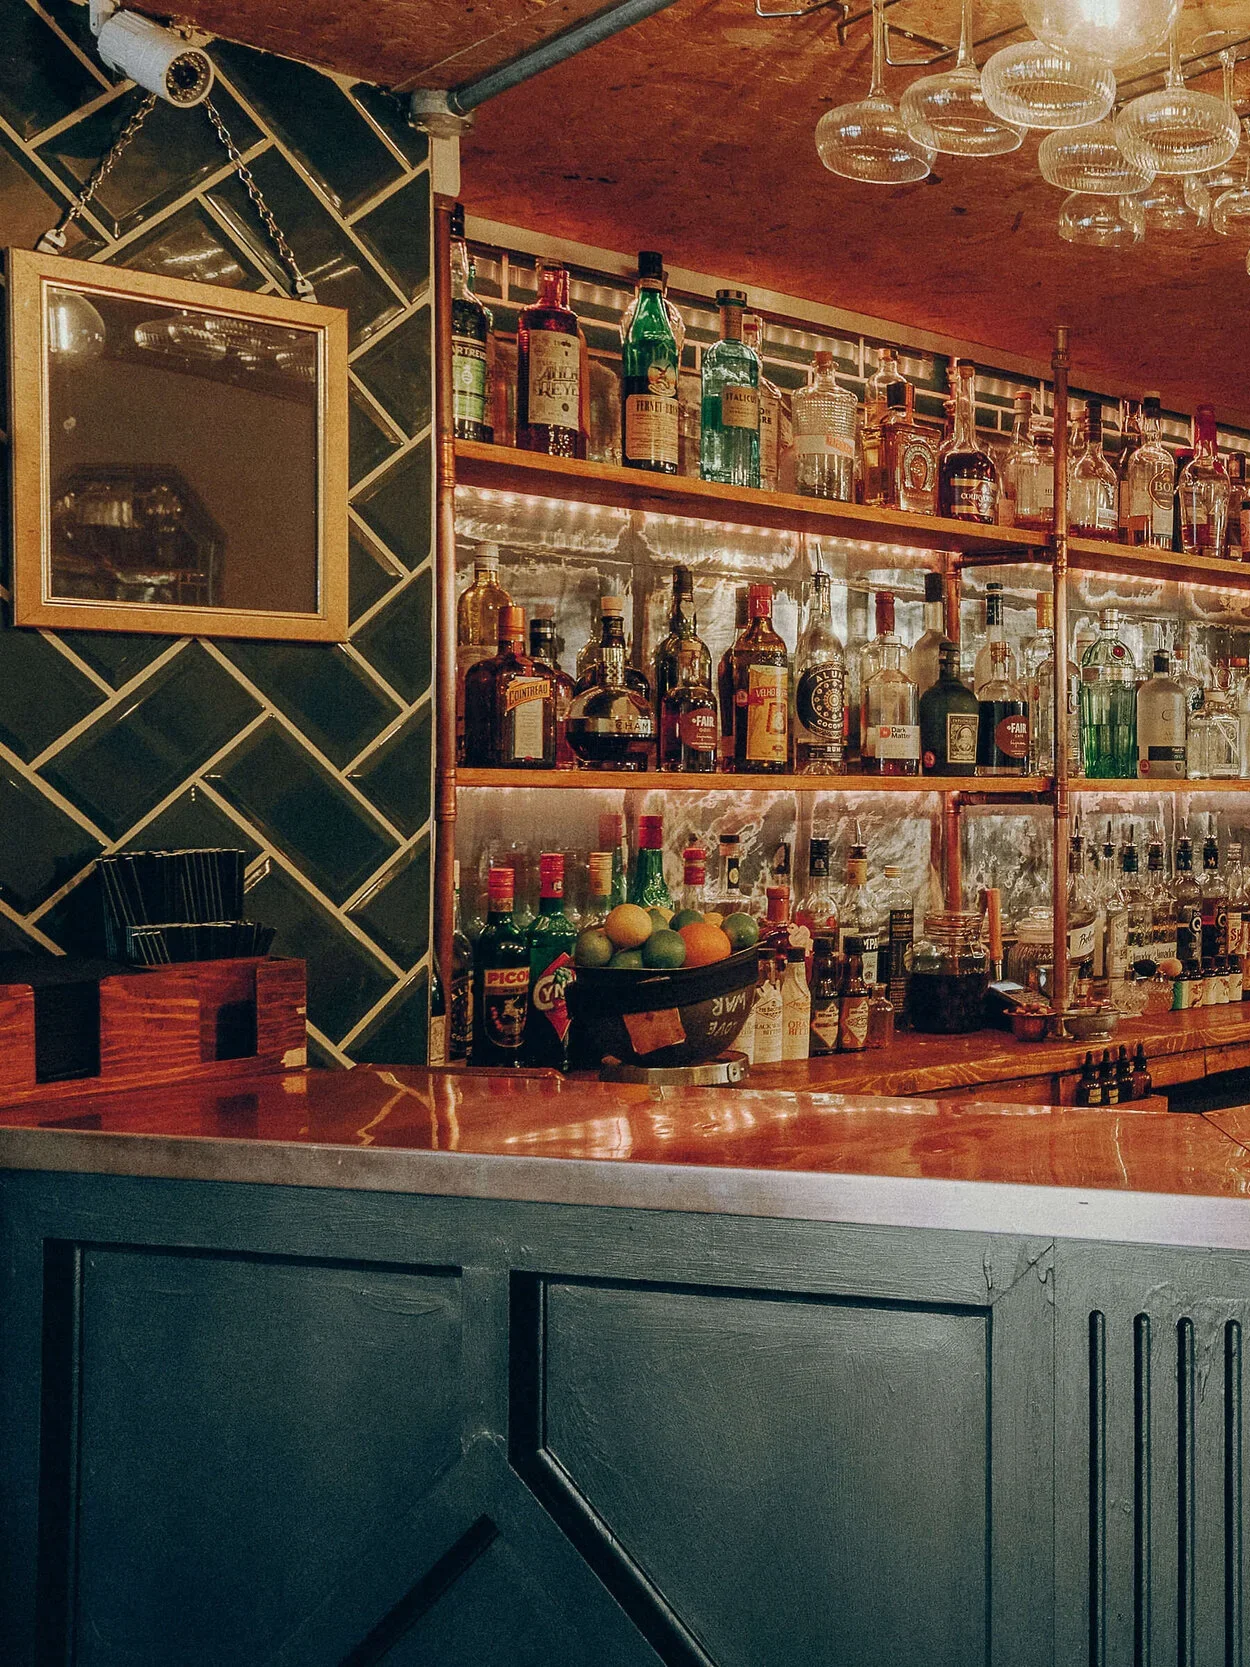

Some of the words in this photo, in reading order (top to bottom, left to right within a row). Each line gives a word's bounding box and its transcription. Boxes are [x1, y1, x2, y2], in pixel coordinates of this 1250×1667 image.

[509, 683, 548, 704] COINTREAU
[696, 715, 715, 728] FAIR
[1011, 722, 1027, 734] FAIR
[891, 726, 907, 734] Dark
[711, 991, 747, 1017] WAR
